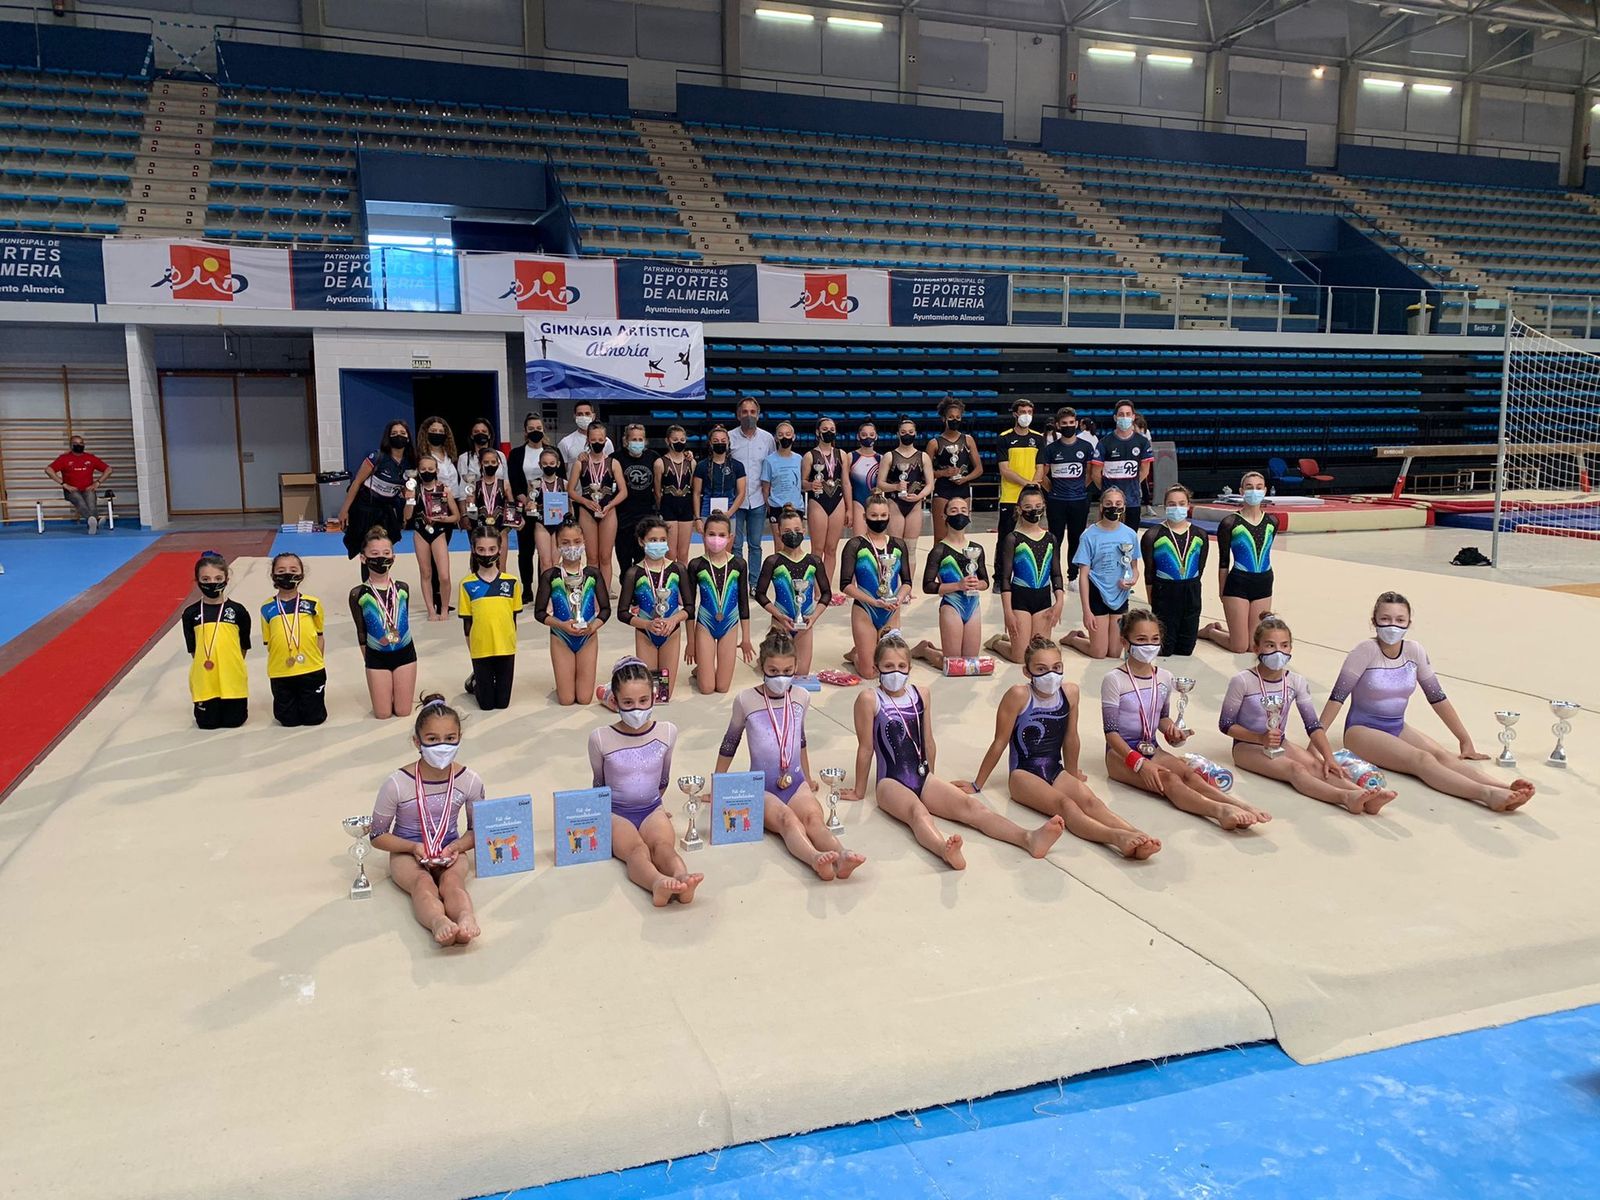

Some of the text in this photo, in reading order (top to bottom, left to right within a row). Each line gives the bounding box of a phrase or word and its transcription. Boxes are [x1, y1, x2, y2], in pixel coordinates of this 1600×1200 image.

[684, 267, 718, 275] MUNICIPAL
[324, 276, 347, 288] DE
[643, 274, 728, 288] DEPORTES
[644, 288, 729, 301] DE ALMERIA
[912, 284, 985, 296] DEPORTES
[912, 296, 985, 309] DE ALMERIA
[645, 305, 699, 314] Ayuntamiento
[913, 313, 959, 321] Ayuntamiento
[540, 322, 612, 336] GIMNASIA
